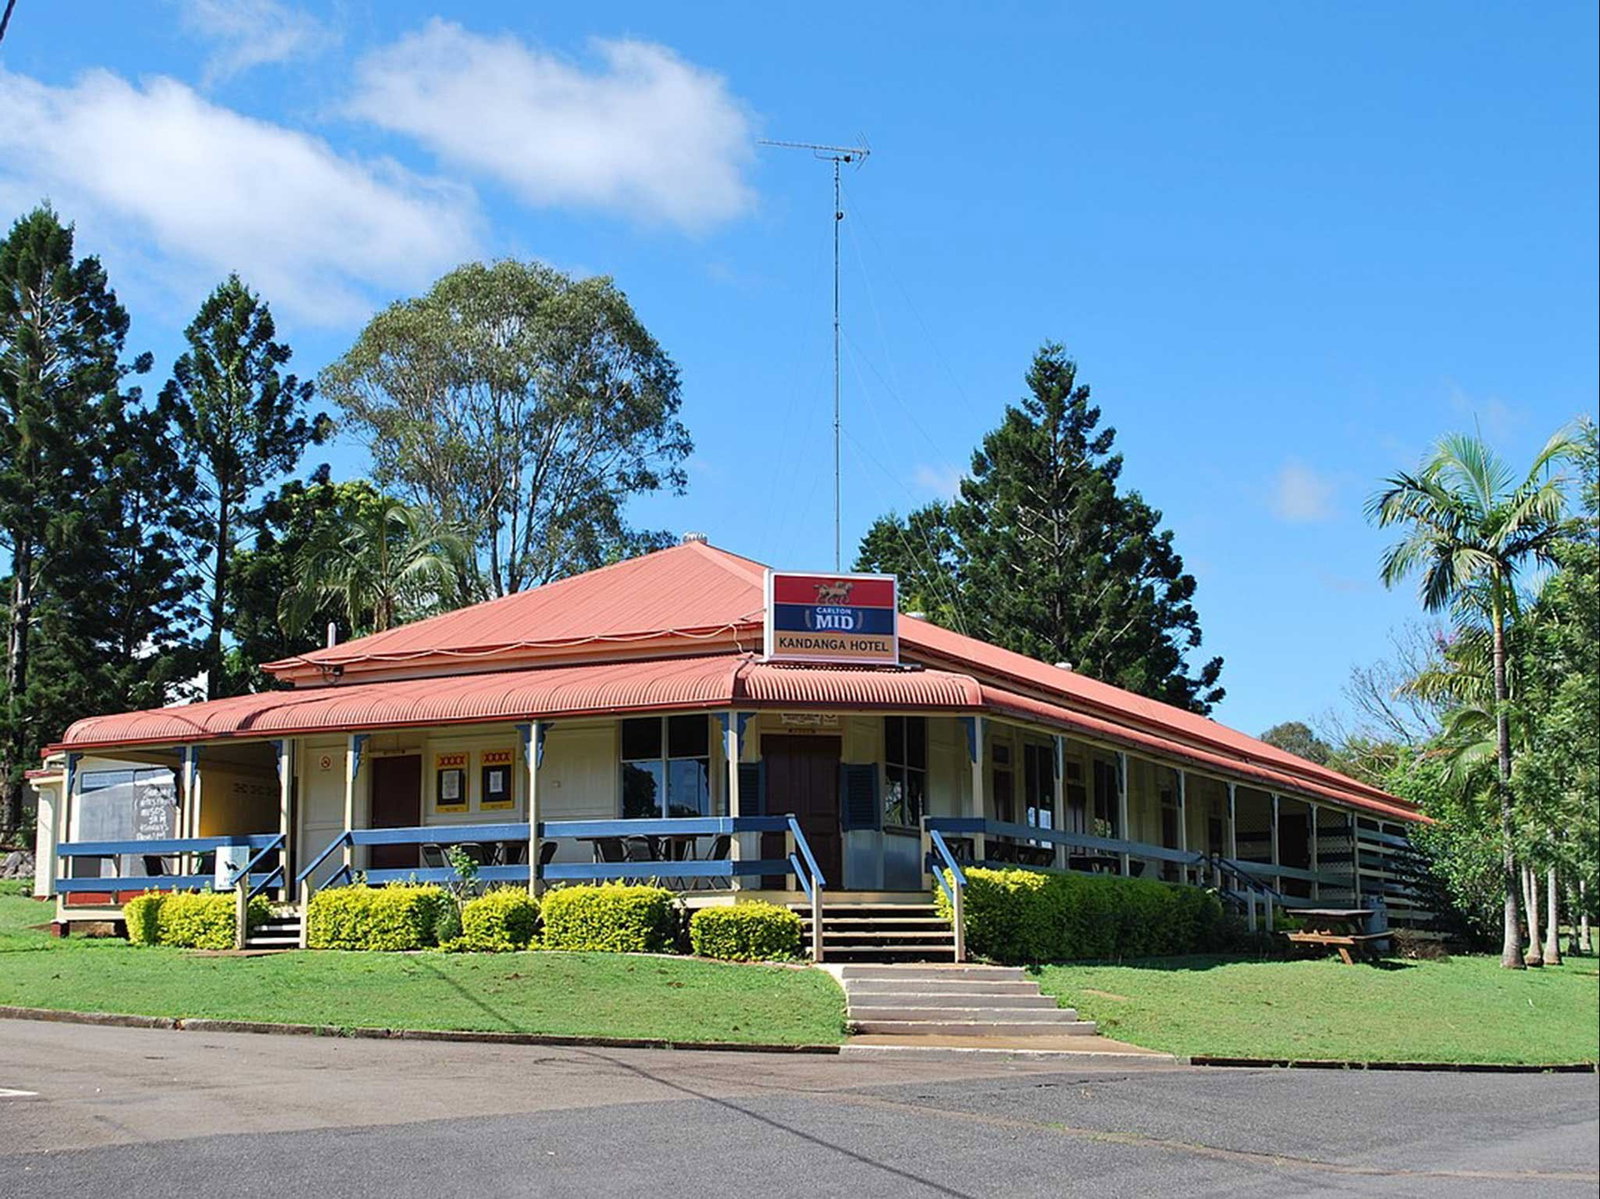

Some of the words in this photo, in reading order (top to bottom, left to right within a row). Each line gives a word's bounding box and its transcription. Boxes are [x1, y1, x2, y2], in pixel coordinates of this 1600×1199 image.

[815, 606, 852, 615] CARLTON
[815, 615, 854, 630] MID
[779, 637, 846, 650] KANDANGA
[850, 640, 889, 652] HOTEL
